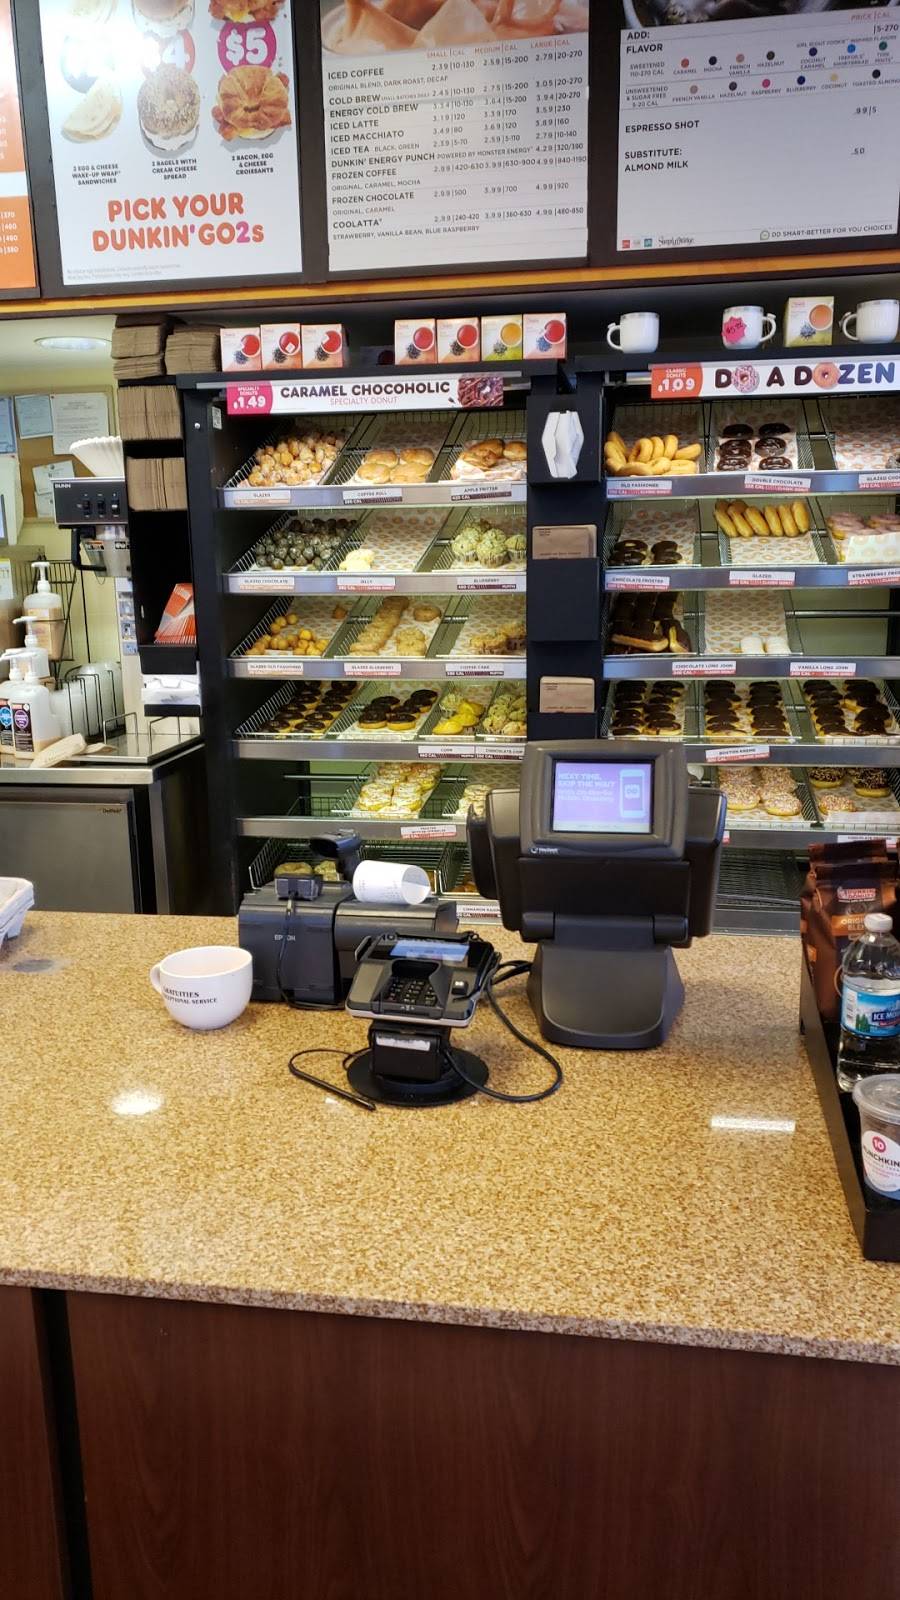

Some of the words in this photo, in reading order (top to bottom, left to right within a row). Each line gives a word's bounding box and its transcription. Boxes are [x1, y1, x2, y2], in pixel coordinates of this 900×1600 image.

[627, 31, 650, 41] ADD:
[226, 28, 268, 66] $5
[626, 43, 664, 54] FLAVOR
[630, 61, 665, 71] SWEETENED
[328, 72, 348, 80] ICED
[350, 68, 385, 78] COFFEE
[729, 69, 751, 77] VANILLA
[328, 82, 359, 91] ORIGINAL
[359, 80, 383, 89] BLEND,
[383, 79, 401, 87] DARK
[402, 77, 426, 86] ROAST,
[427, 75, 449, 83] DECAF
[625, 86, 669, 95] UNSWEETENED
[751, 88, 782, 96] RASPBERRY
[786, 85, 816, 93] BLUEBERRY
[329, 97, 353, 105] COLD
[355, 94, 382, 103] BREW
[672, 96, 693, 104] FRENCH
[693, 94, 715, 102] VANILLA
[720, 91, 747, 99] HAZELNUT
[330, 108, 364, 118] ENERGY
[367, 106, 391, 115] COLD
[392, 103, 419, 113] BREW
[330, 122, 350, 130] ICED
[352, 119, 379, 128] LATTE
[625, 122, 673, 133] ESPRESSO
[674, 119, 700, 130] SHOT
[330, 134, 351, 143] ICED
[352, 130, 405, 141] MACCHIATO
[331, 146, 351, 155] ICED
[354, 145, 370, 154] TEA
[624, 147, 683, 159] SUBSTITUTE:
[156, 159, 179, 167] BAGELS
[180, 158, 197, 166] WITH
[331, 157, 366, 168] DUNKIN'
[368, 155, 403, 165] ENERGY
[405, 152, 435, 162] PUNCH
[437, 152, 467, 160] POWERED
[477, 149, 506, 157] MONSTER
[96, 163, 119, 171] CHEESE
[244, 160, 267, 168] CHEESE
[624, 162, 665, 172] ALMOND
[667, 160, 689, 169] MILK
[152, 166, 174, 174] CREAM
[174, 165, 197, 173] CHEESE
[235, 167, 274, 175] CROISSANTS
[332, 170, 364, 180] FROZEN
[366, 168, 397, 178] COFFEE
[72, 171, 100, 179] WAKE-UP
[78, 177, 117, 186] SANDWICHES
[397, 179, 421, 187] MOCHA
[332, 195, 364, 204] FROZEN
[366, 191, 415, 203] CHOCOLATE
[108, 197, 167, 222] PICK
[172, 192, 245, 219] YOUR
[366, 206, 395, 214] CARAMEL
[378, 230, 403, 238] VANILLA
[425, 227, 441, 235] BLUE
[443, 225, 480, 233] RASPBERRY
[833, 226, 846, 234] FOR
[848, 225, 861, 233] YOU
[863, 224, 893, 232] CHOICES
[92, 224, 196, 253] DUNKIN'
[767, 366, 785, 388] A
[280, 385, 347, 399] CARAMEL
[352, 381, 450, 397] CHOCOHOLIC
[330, 396, 368, 406] SPECIALTY
[371, 396, 398, 405] DONUT
[773, 478, 803, 486] CHOCOLATE
[274, 934, 296, 942] EPON
[191, 997, 217, 1005] SERVICE
[873, 1013, 885, 1021] ICE
[873, 1138, 885, 1150] 10
